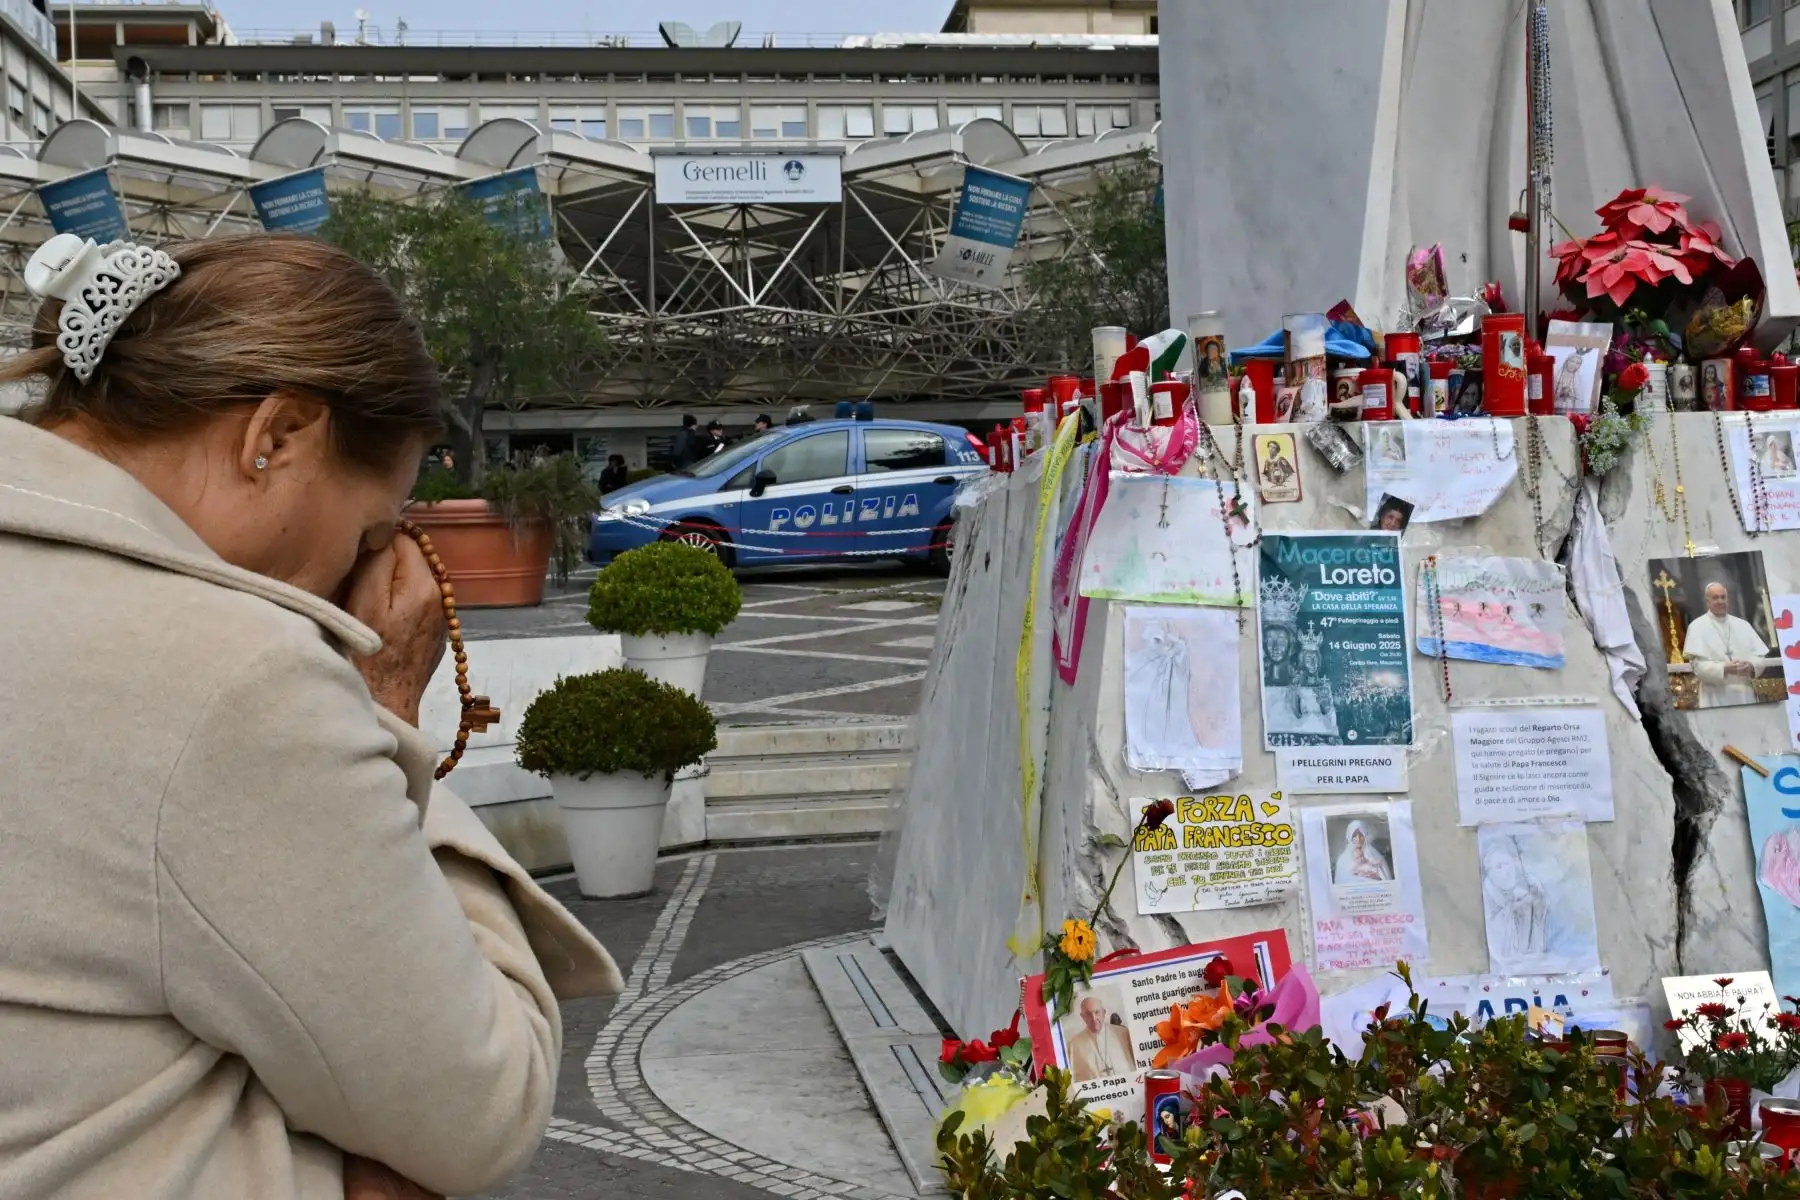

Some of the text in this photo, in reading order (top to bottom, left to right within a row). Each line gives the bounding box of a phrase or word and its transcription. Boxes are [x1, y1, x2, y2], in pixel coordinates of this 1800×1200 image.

[683, 160, 767, 181] Gemelli
[957, 450, 981, 463] 113
[769, 493, 920, 532] POLIZIA
[1277, 540, 1394, 565] Macerata
[1319, 563, 1395, 585] Loreto
[1377, 632, 1401, 640] Sabato
[1328, 640, 1401, 652] 14 Giugno 2025
[1519, 724, 1531, 733] del
[1532, 723, 1562, 733] Reparto
[1563, 723, 1580, 731] Orsa
[1470, 738, 1504, 746] Maggiore
[1518, 736, 1546, 745] Gruppo
[1508, 748, 1536, 758] pregato
[1580, 747, 1592, 755] per
[1297, 759, 1347, 767] PELLEGRINI
[1349, 758, 1392, 767] PREGANO
[1502, 760, 1510, 768] di
[1511, 760, 1530, 769] Papa
[1317, 775, 1370, 784] PER IL PAPA
[1479, 773, 1506, 782] Signore
[1542, 771, 1567, 779] ancora
[1568, 770, 1589, 778] come
[1474, 785, 1494, 794] guida
[1502, 784, 1538, 792] testimone
[1517, 796, 1541, 804] amore
[1176, 794, 1256, 824] FORZA
[1134, 822, 1294, 852] PAPA FRANCESCO
[1191, 874, 1206, 885] TU
[1316, 914, 1415, 932] PAPA FRANCESCO
[1131, 967, 1207, 988] Santo Padre le augu
[1135, 992, 1160, 1006] pronta
[1138, 1039, 1167, 1052] GIUBIL
[1136, 1059, 1147, 1069] ha
[1081, 1077, 1127, 1091] S.S. Papa
[1088, 1087, 1135, 1103] ancesco I
